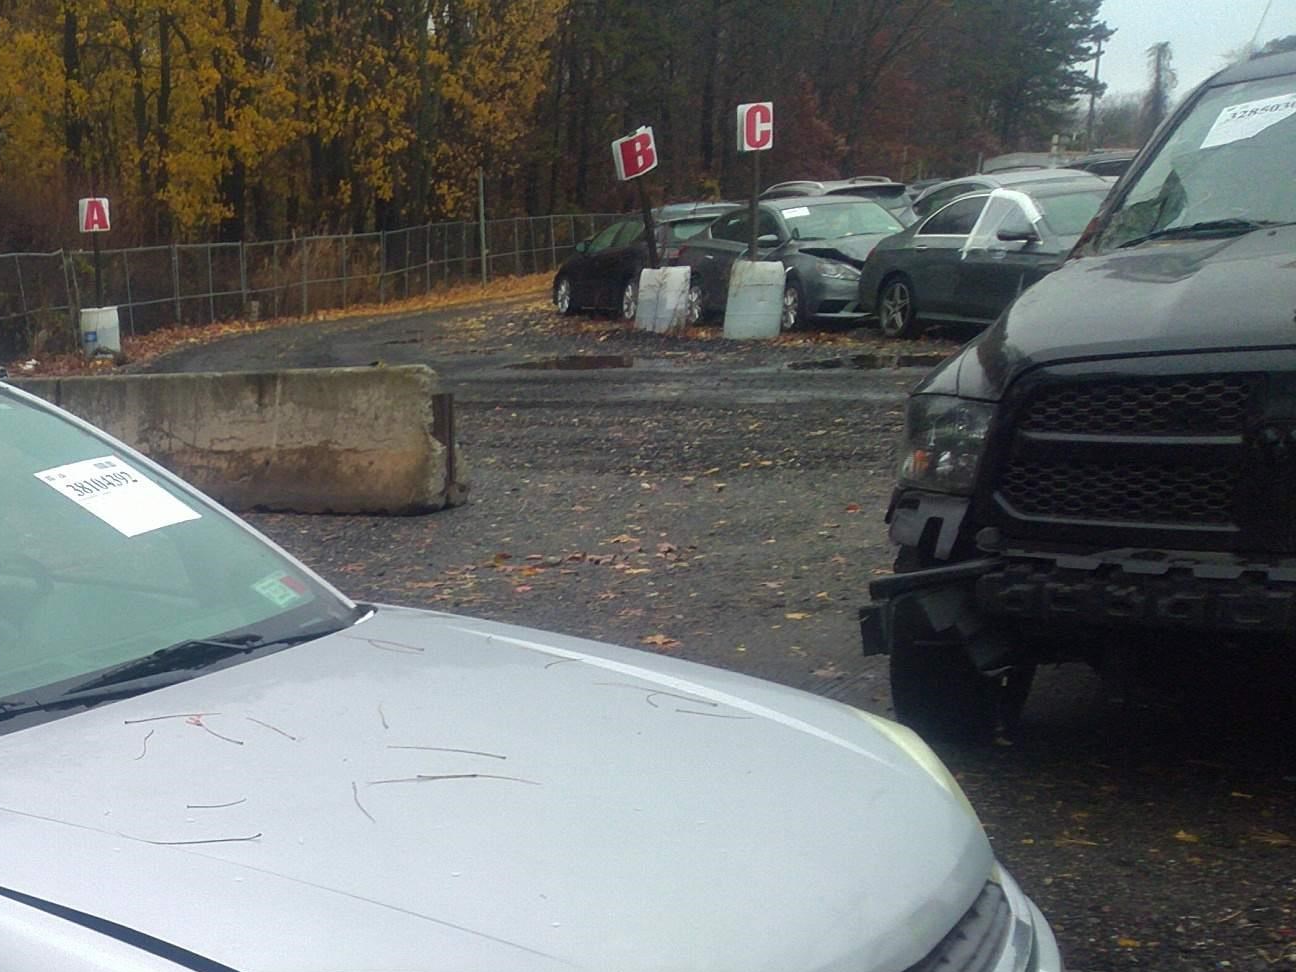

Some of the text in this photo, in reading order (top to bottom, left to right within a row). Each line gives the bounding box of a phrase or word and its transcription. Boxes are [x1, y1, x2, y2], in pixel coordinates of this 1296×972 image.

[745, 104, 772, 149] C
[620, 132, 655, 178] B
[84, 200, 109, 230] A
[65, 471, 138, 497] 38104392
